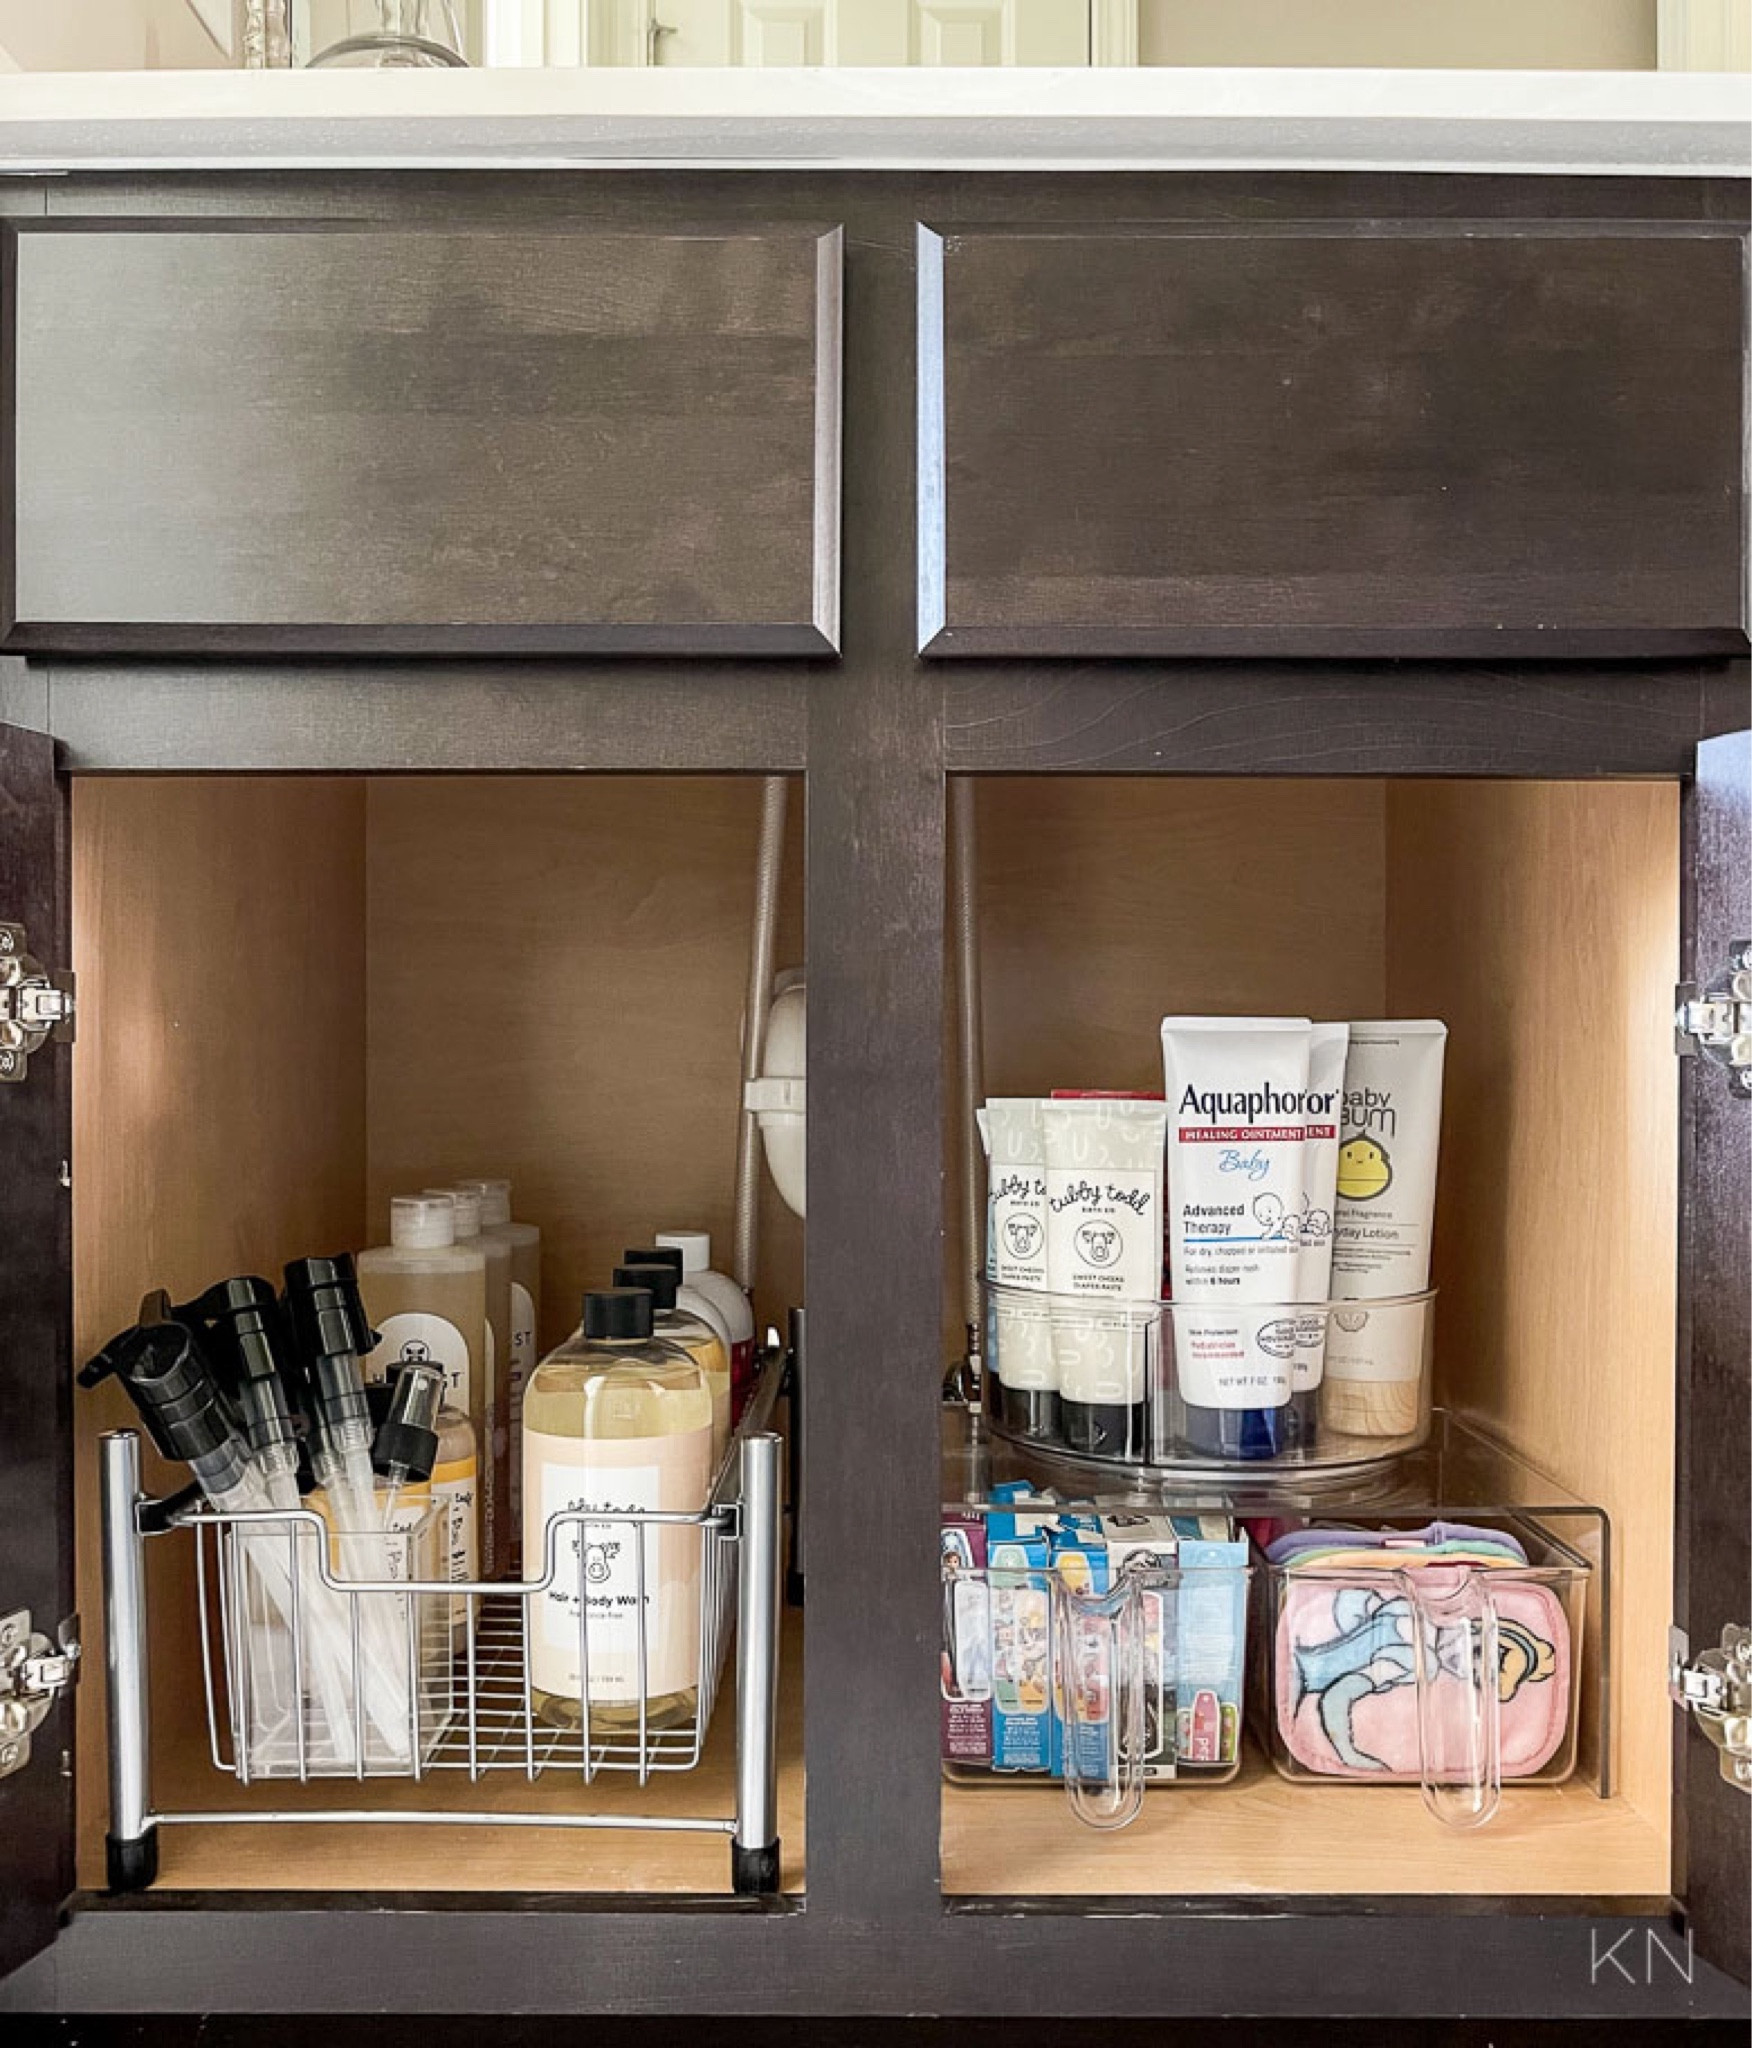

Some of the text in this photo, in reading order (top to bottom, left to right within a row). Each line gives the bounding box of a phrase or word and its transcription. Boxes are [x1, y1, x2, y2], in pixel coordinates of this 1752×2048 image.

[1179, 1082, 1305, 1125] Aquaphor
[1185, 1129, 1302, 1140] HEALING OINTMENT
[1218, 1149, 1270, 1181] Baby
[1050, 1180, 1150, 1215] tubby todd
[1183, 1203, 1245, 1216] Advanced
[1351, 1209, 1393, 1219] Fragrance
[1184, 1221, 1232, 1235] Therapy
[1362, 1227, 1400, 1239] Lotion
[1184, 1246, 1198, 1255] For
[1218, 1276, 1240, 1285] hours
[549, 1591, 569, 1602] Hair
